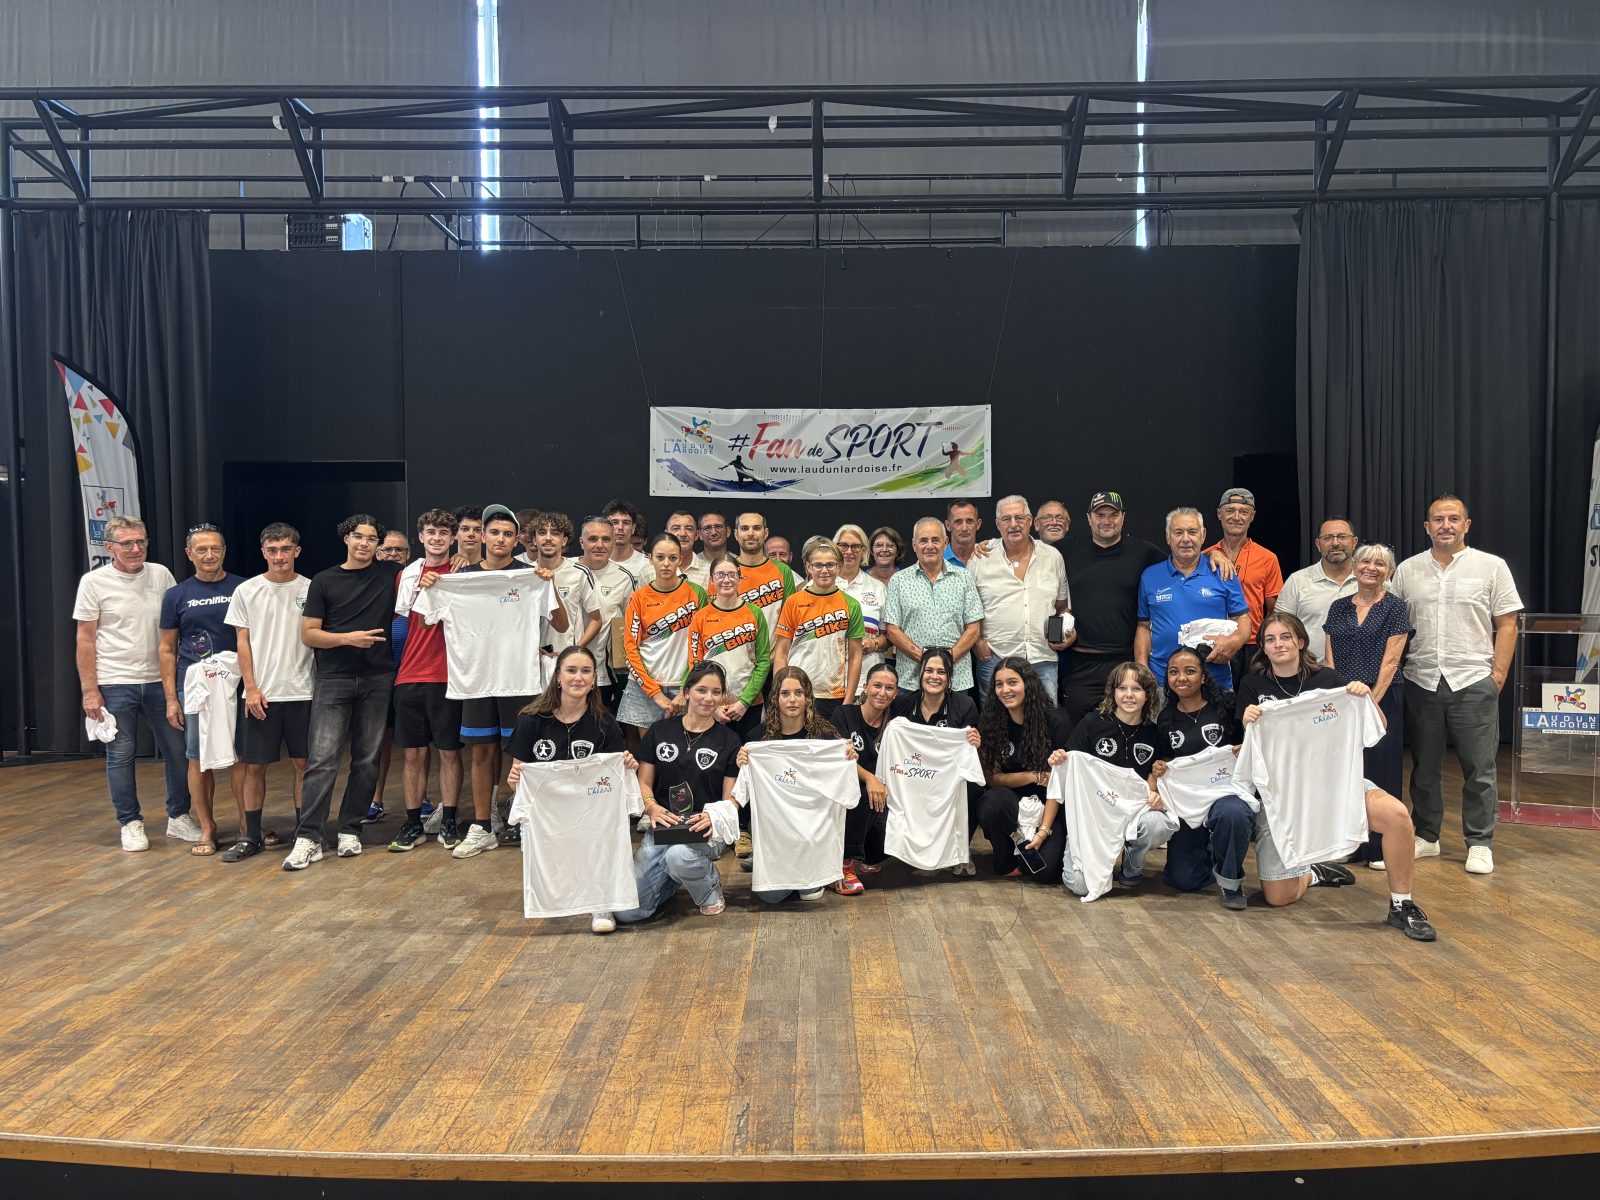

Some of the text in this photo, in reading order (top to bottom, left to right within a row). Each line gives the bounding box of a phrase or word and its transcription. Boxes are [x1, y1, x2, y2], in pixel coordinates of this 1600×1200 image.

[807, 443, 824, 458] de
[822, 421, 943, 463] SPORT
[770, 464, 902, 474] www.laudunlardoise.fr
[738, 579, 784, 602] ESAR
[187, 596, 232, 608] Tecnifibr
[647, 600, 698, 635] CESAR
[795, 609, 849, 636] CESAR
[815, 618, 850, 638] BIKE
[704, 622, 757, 650] CESAR
[724, 630, 757, 651] BIKE
[908, 767, 939, 780] SPORT
